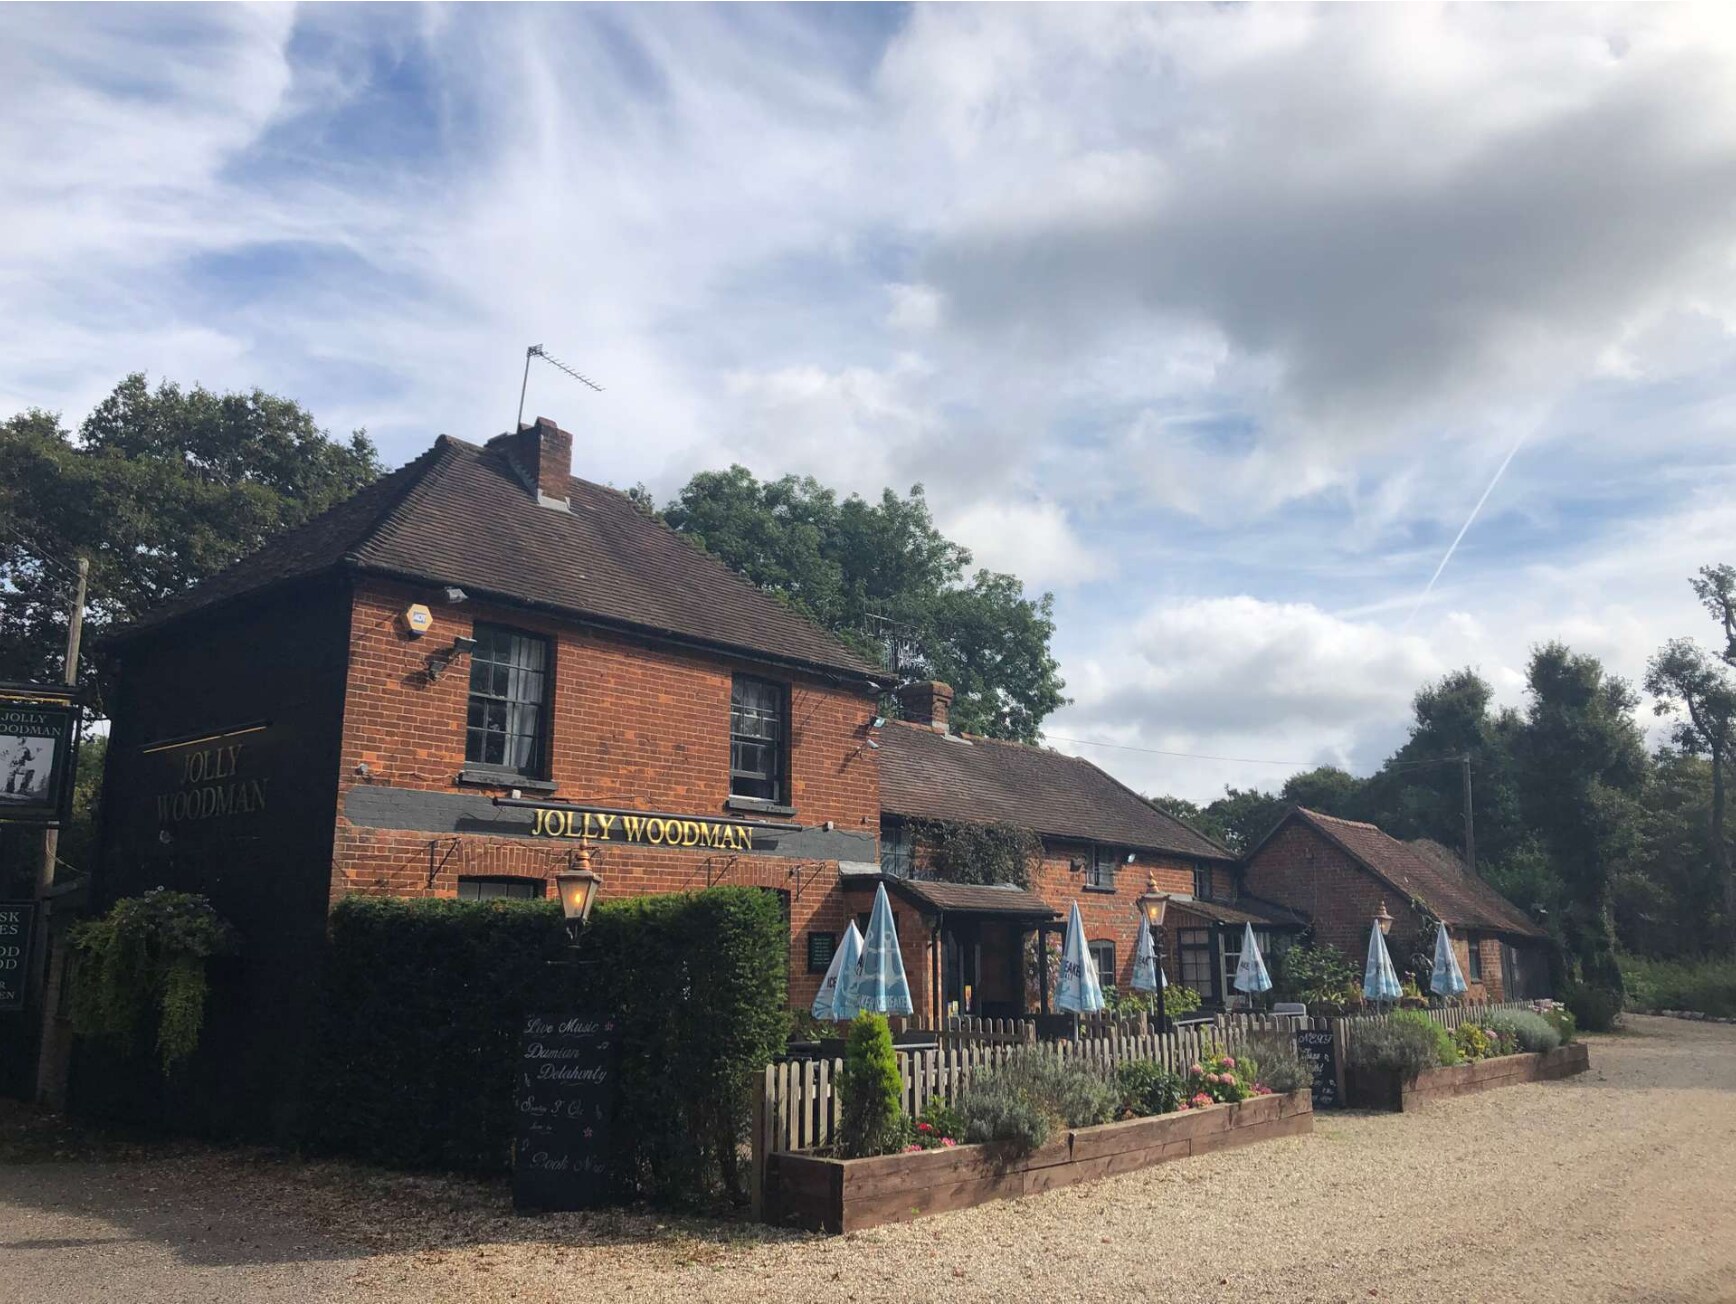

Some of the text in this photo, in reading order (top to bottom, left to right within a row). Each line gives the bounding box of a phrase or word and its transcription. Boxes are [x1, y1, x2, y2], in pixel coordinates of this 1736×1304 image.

[1, 711, 47, 724] JOLLY
[0, 724, 61, 736] OODMAN
[180, 744, 244, 784] JOLLY
[156, 777, 270, 823] WOODMAN
[532, 808, 754, 850] JOLLY WOODMAN
[0, 912, 20, 923] SK
[0, 924, 18, 935] ES
[0, 946, 20, 957] OD
[523, 1017, 599, 1034] Live Music
